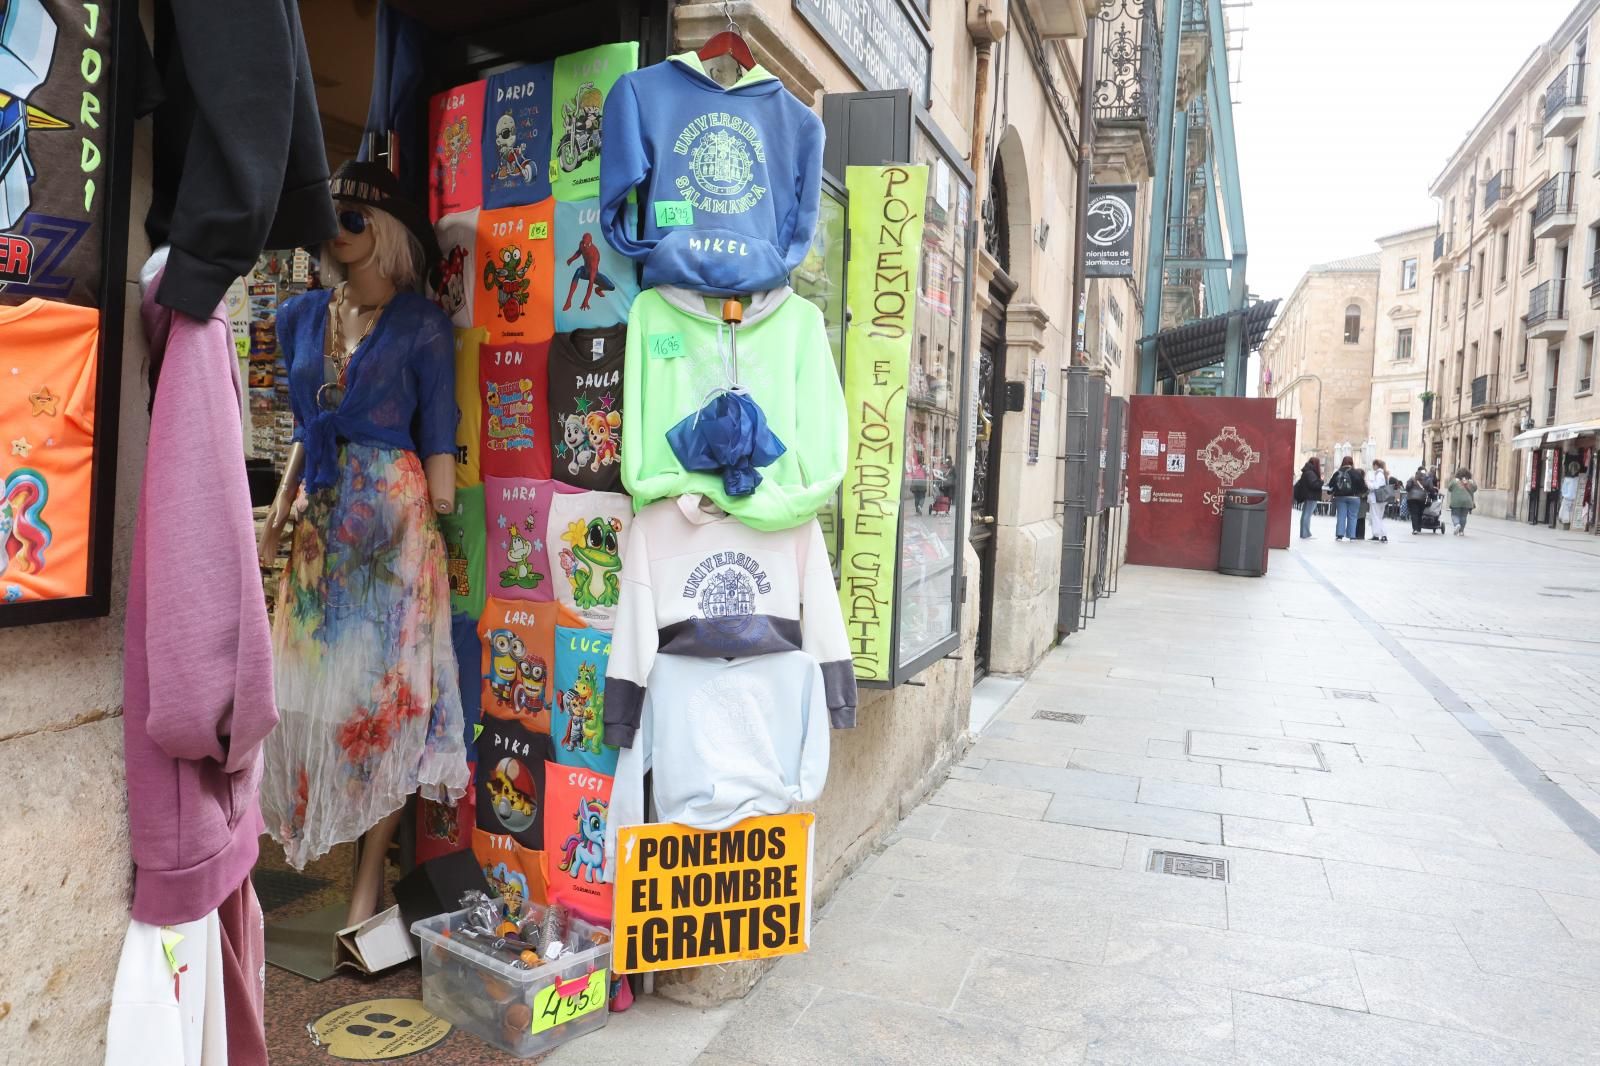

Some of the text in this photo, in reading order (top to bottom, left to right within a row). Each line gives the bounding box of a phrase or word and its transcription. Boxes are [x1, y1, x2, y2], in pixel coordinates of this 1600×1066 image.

[439, 94, 466, 110] ALBA
[496, 82, 535, 103] DARIO
[80, 3, 102, 213] JORDI
[674, 112, 768, 163] UNIVERSIDAD
[675, 176, 767, 214] SALAMANCA
[492, 219, 524, 237] JOTA
[689, 237, 749, 256] MIKEL
[494, 351, 523, 366] JON
[575, 370, 620, 390] PAULA
[847, 167, 918, 679] PONEMOS EL NOMBRE GRATIS
[502, 487, 536, 501] MARA
[683, 551, 772, 599] UNIVERSIDAD
[504, 611, 535, 627] LARA
[570, 637, 611, 656] LUCA
[494, 733, 530, 757] PIKA
[568, 773, 603, 792] SUSI
[638, 826, 786, 872] PONEMOS
[631, 865, 798, 913] EL NOMBRE
[625, 902, 801, 970] ¡GRATIS!
